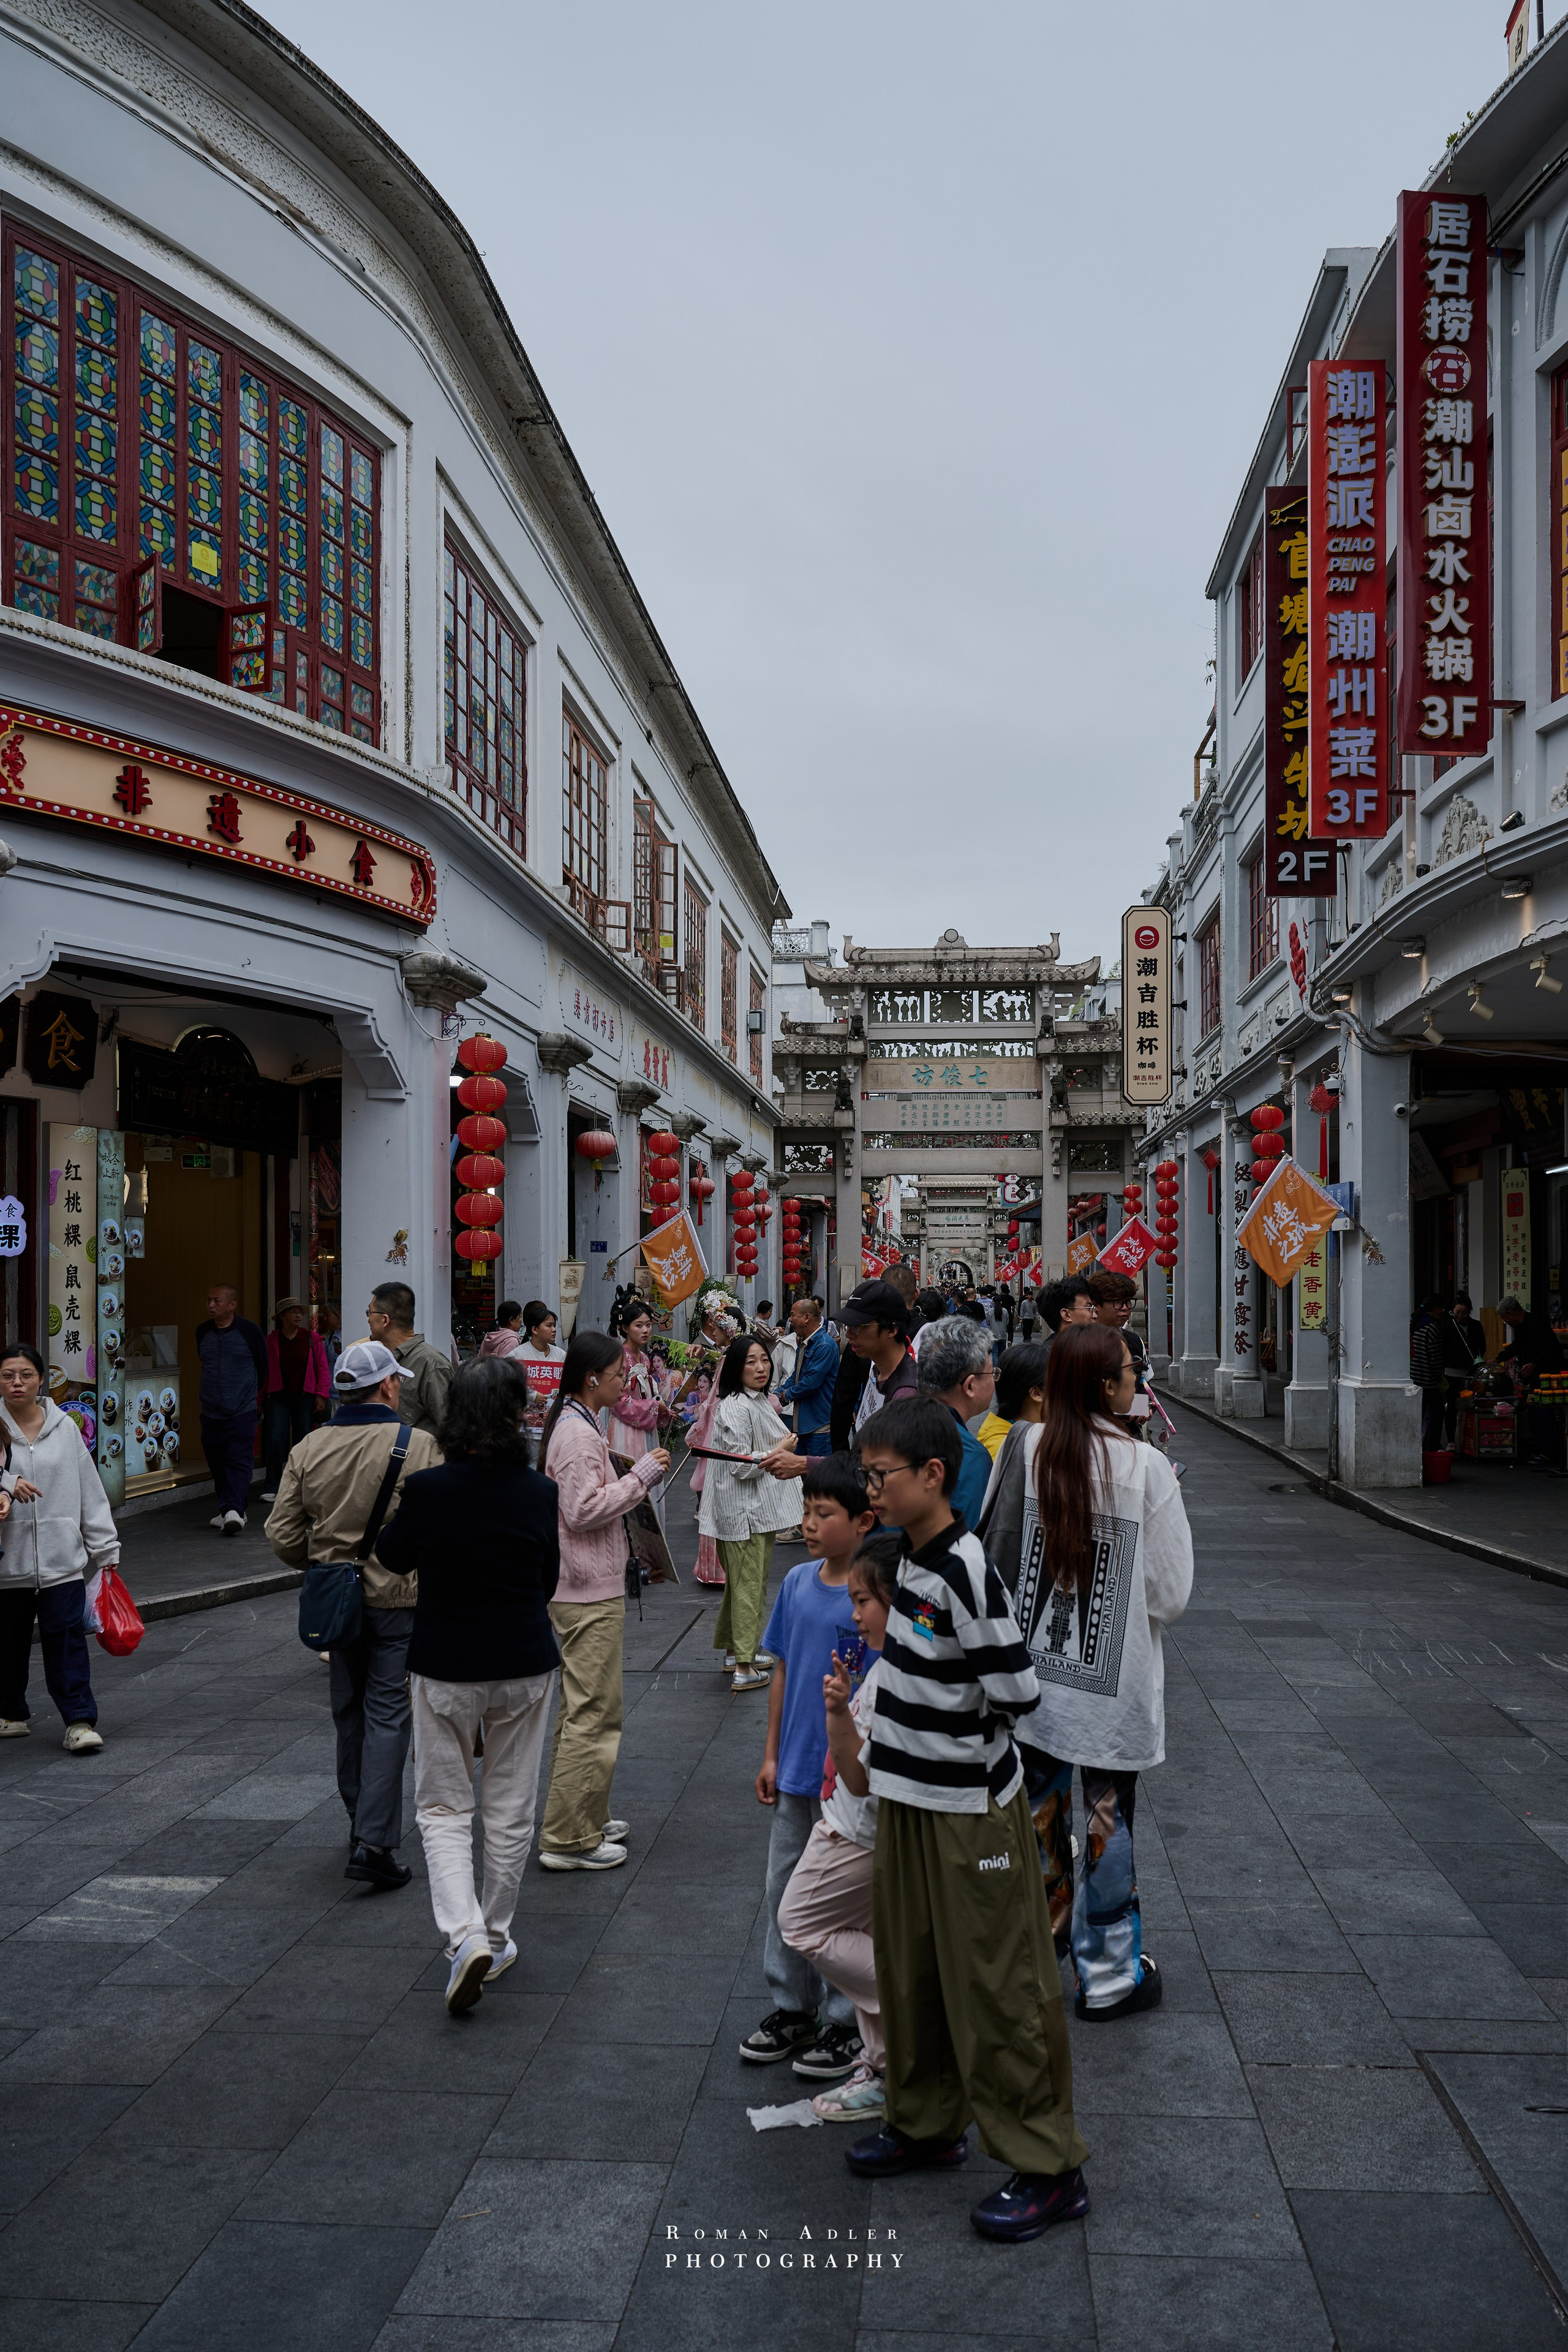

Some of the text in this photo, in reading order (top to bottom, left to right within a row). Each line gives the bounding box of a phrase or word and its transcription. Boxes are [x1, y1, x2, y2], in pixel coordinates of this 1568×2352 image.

[1424, 200, 1474, 343] 居石捞
[1327, 369, 1376, 529] 潮澎派
[1327, 537, 1376, 552] CHAO
[1327, 557, 1376, 573] PENG
[1424, 397, 1474, 682] 潮汕卤水火锅
[1327, 577, 1357, 592] PAI
[1327, 610, 1378, 778] 潮州菜
[1419, 696, 1479, 739] 3F
[113, 764, 378, 886] 非遗小食
[1325, 788, 1378, 824] 3F
[1277, 850, 1330, 882] 2F
[1136, 957, 1159, 1056] 潮吉胜杯
[41, 1011, 85, 1071] 食
[1137, 1061, 1156, 1069] 咖啡
[64, 1159, 82, 1354] 红桃粿 鼠壳粿
[1303, 1251, 1323, 1319] 老香黄
[1101, 1577, 1116, 1636] THAILAND
[979, 1851, 1010, 1871] mini
